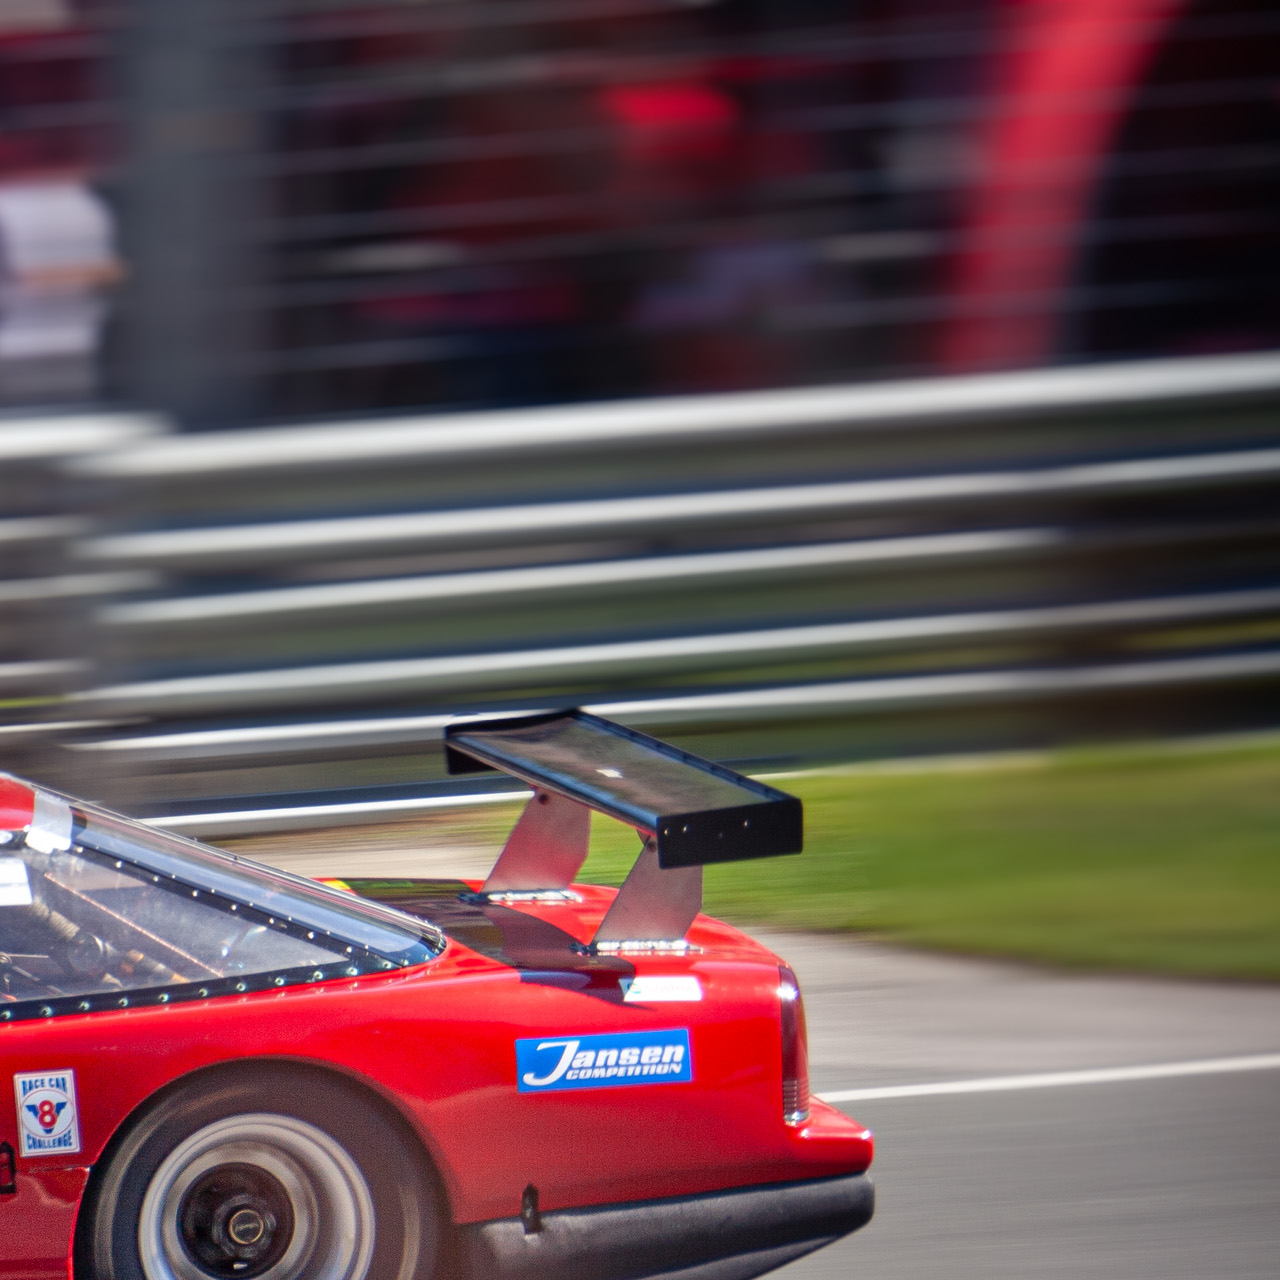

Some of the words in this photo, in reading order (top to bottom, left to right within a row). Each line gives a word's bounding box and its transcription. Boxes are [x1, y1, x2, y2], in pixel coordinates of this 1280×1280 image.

[522, 1040, 685, 1087] Jansen
[565, 1062, 682, 1081] COMPETITION
[21, 1078, 46, 1097] RACE
[50, 1077, 68, 1095] CAR
[26, 1130, 73, 1150] CHALLENGE
